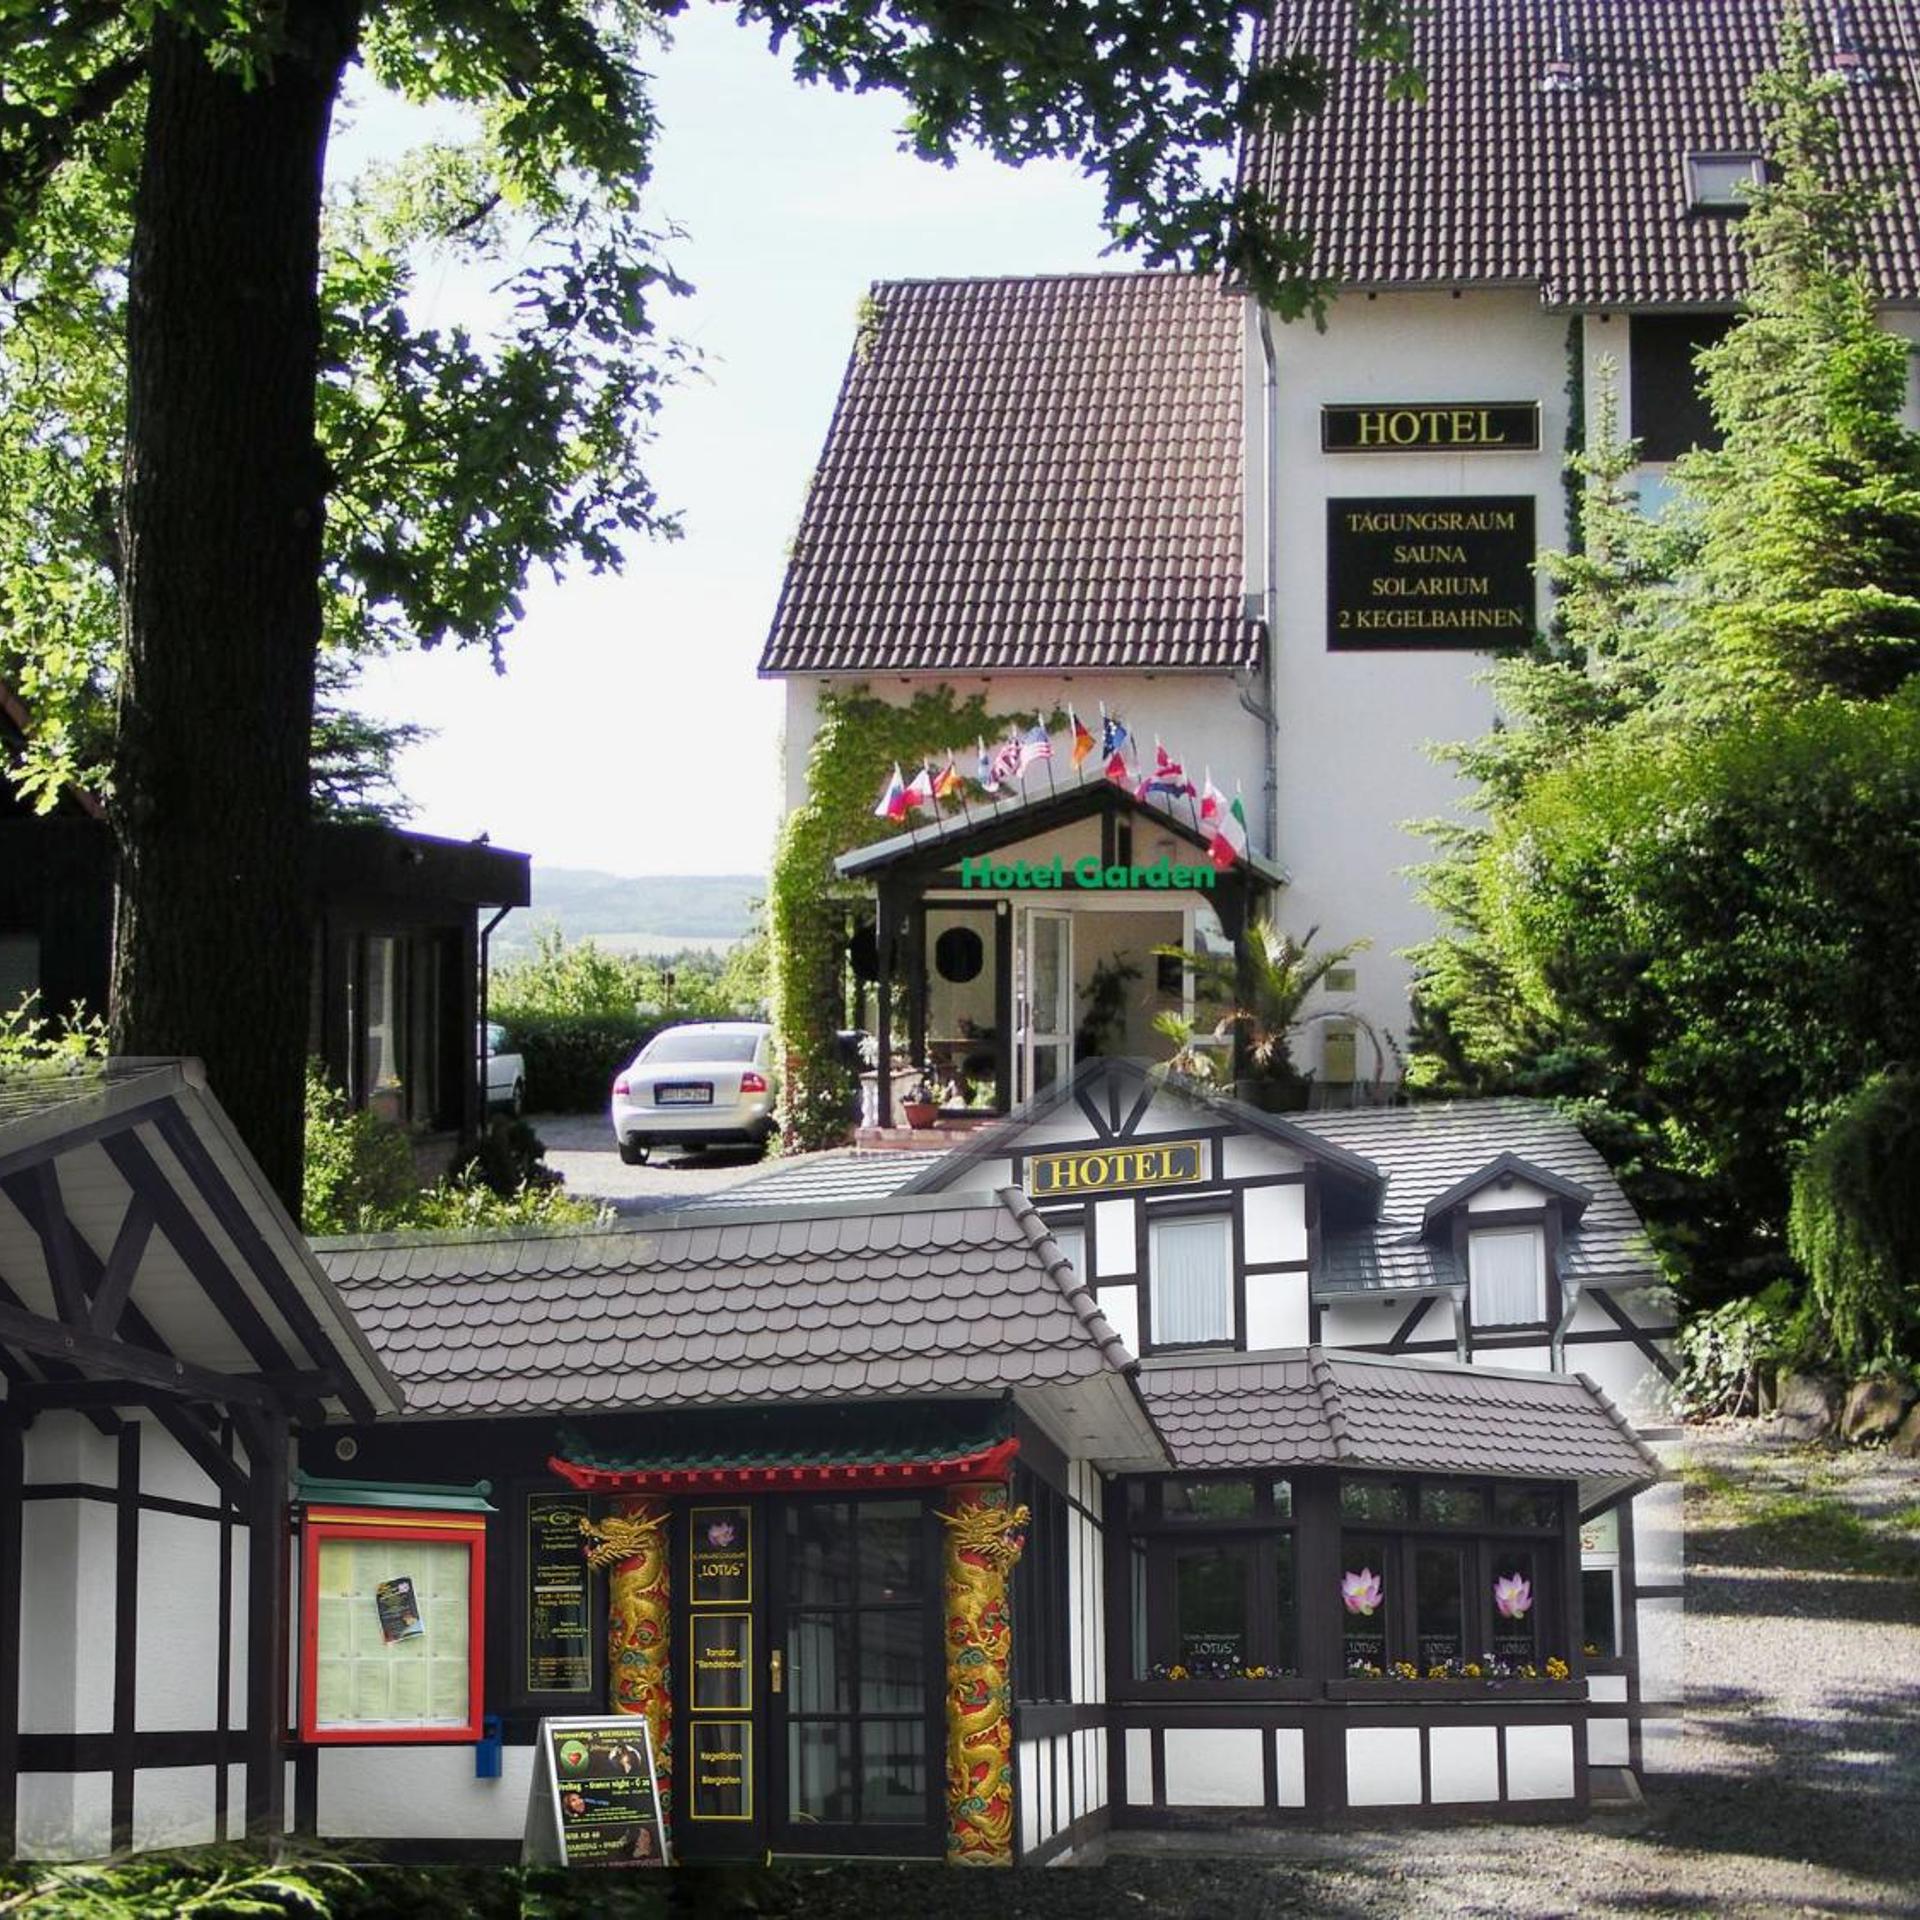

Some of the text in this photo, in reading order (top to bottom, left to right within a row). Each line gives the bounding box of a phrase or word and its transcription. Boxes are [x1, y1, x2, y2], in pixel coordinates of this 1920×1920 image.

[1358, 411, 1505, 444] HOTEL
[1347, 511, 1516, 532] TAGUNGSRAUM
[1393, 545, 1468, 563] SAUNA
[1372, 577, 1489, 596] SOLARIUM
[1339, 608, 1524, 628] 2 KEGELBAHNEN
[1050, 1150, 1184, 1190] HOTEL
[700, 1752, 743, 1762] Kegelbahn
